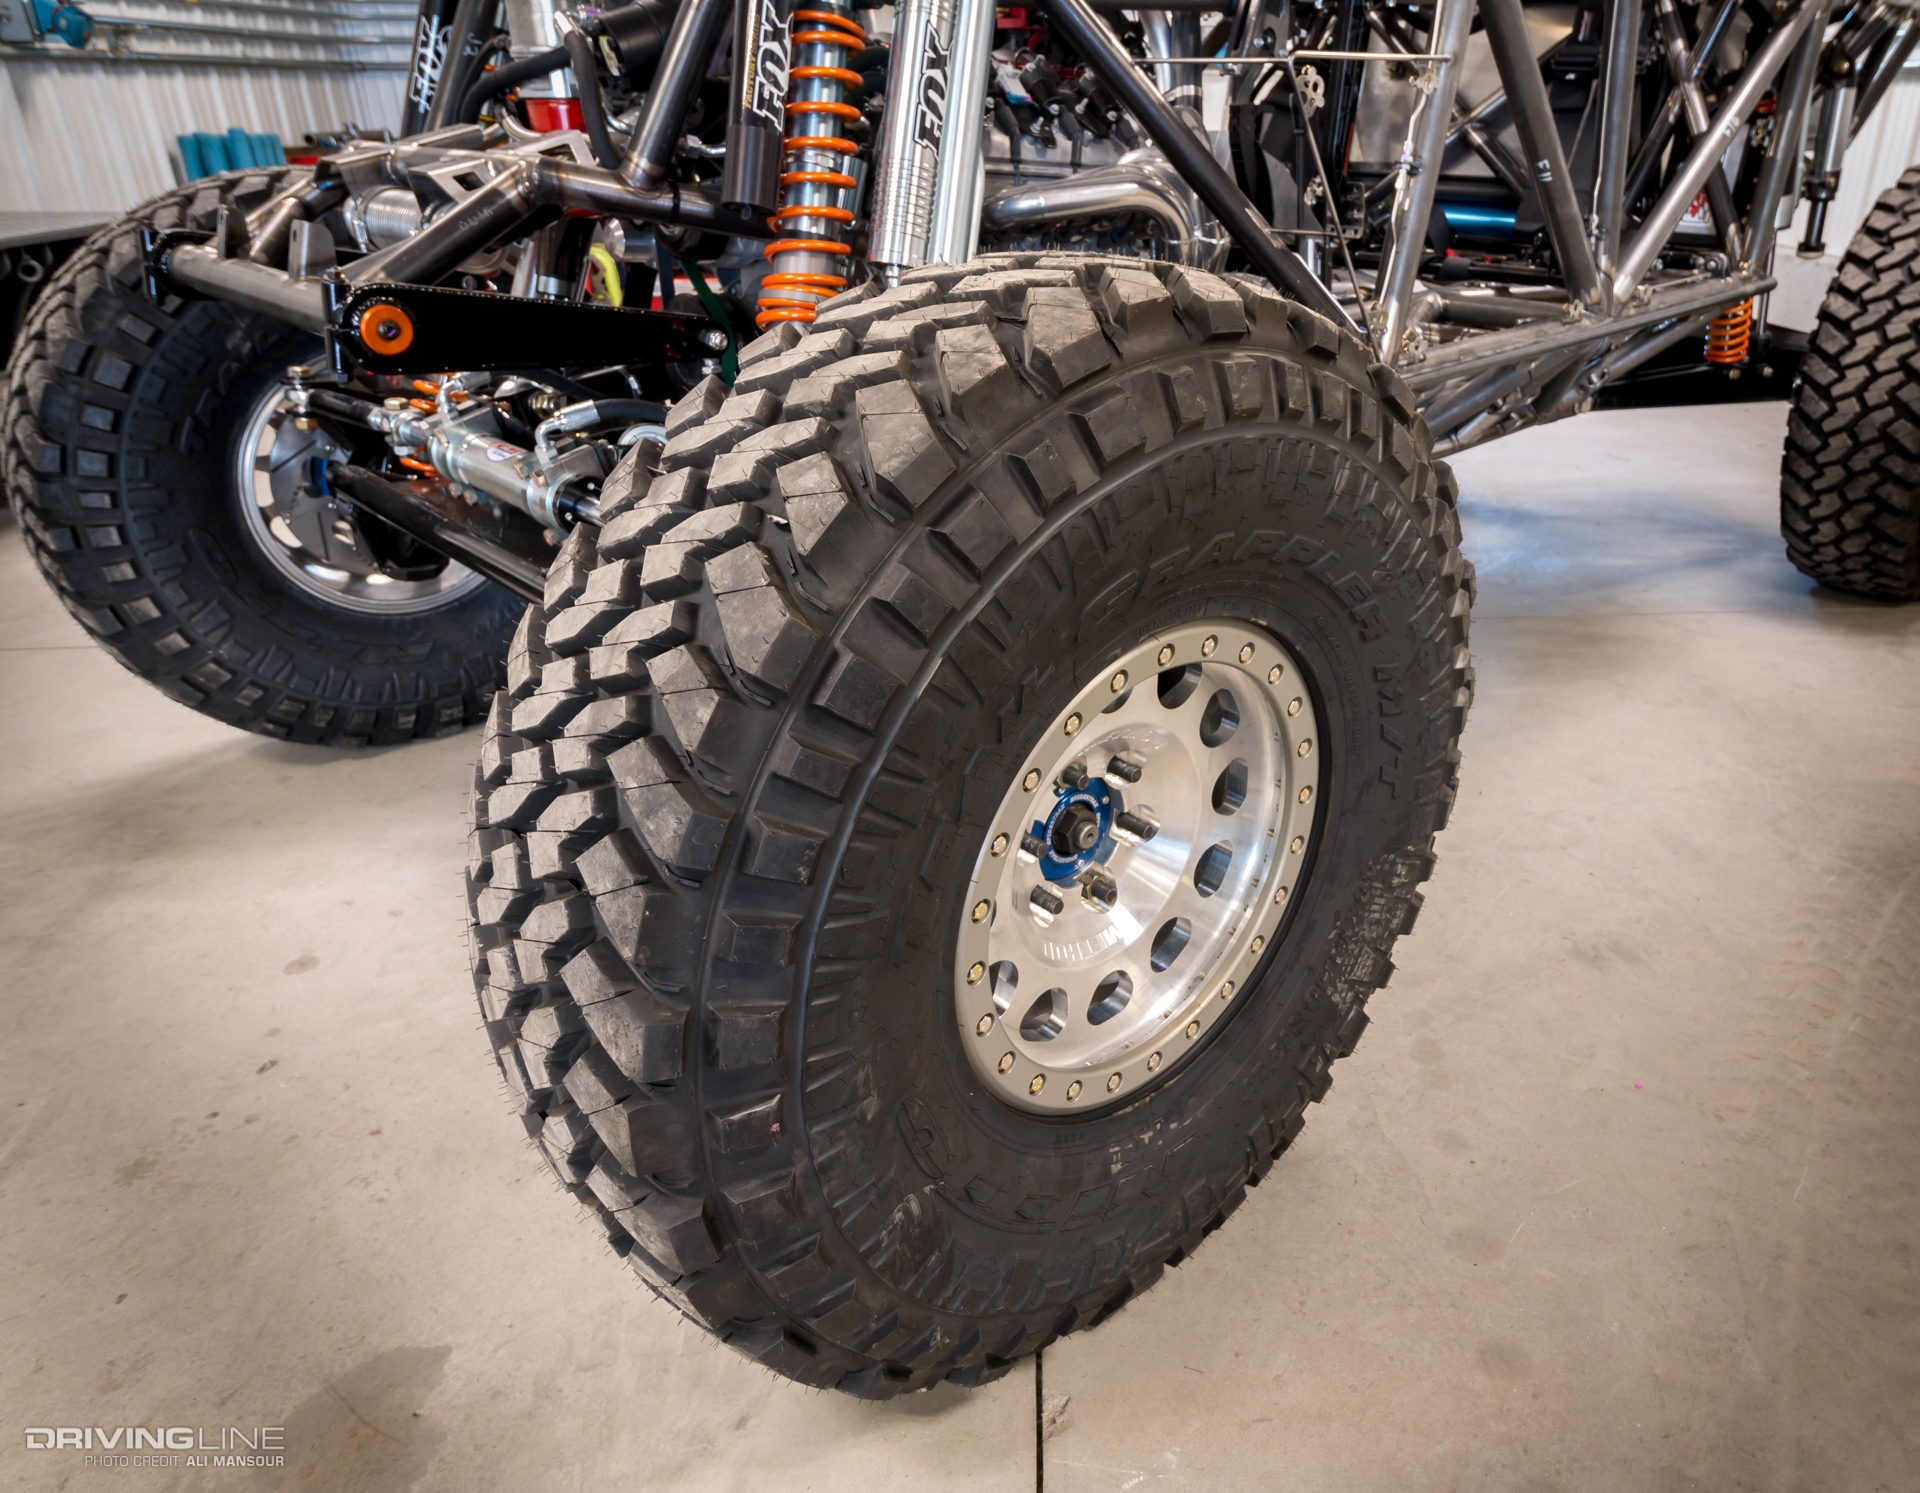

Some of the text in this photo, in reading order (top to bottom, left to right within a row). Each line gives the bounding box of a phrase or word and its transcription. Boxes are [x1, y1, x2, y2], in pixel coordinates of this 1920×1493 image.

[409, 14, 452, 111] FOX
[744, 55, 758, 109] FACTORY
[753, 0, 793, 132] FOX
[913, 20, 954, 162] FOX
[1076, 528, 1391, 644] GRAPPLER
[1373, 661, 1405, 800] M/T
[1046, 803, 1066, 846] SPIDERTRAX
[1044, 923, 1124, 962] METHOD
